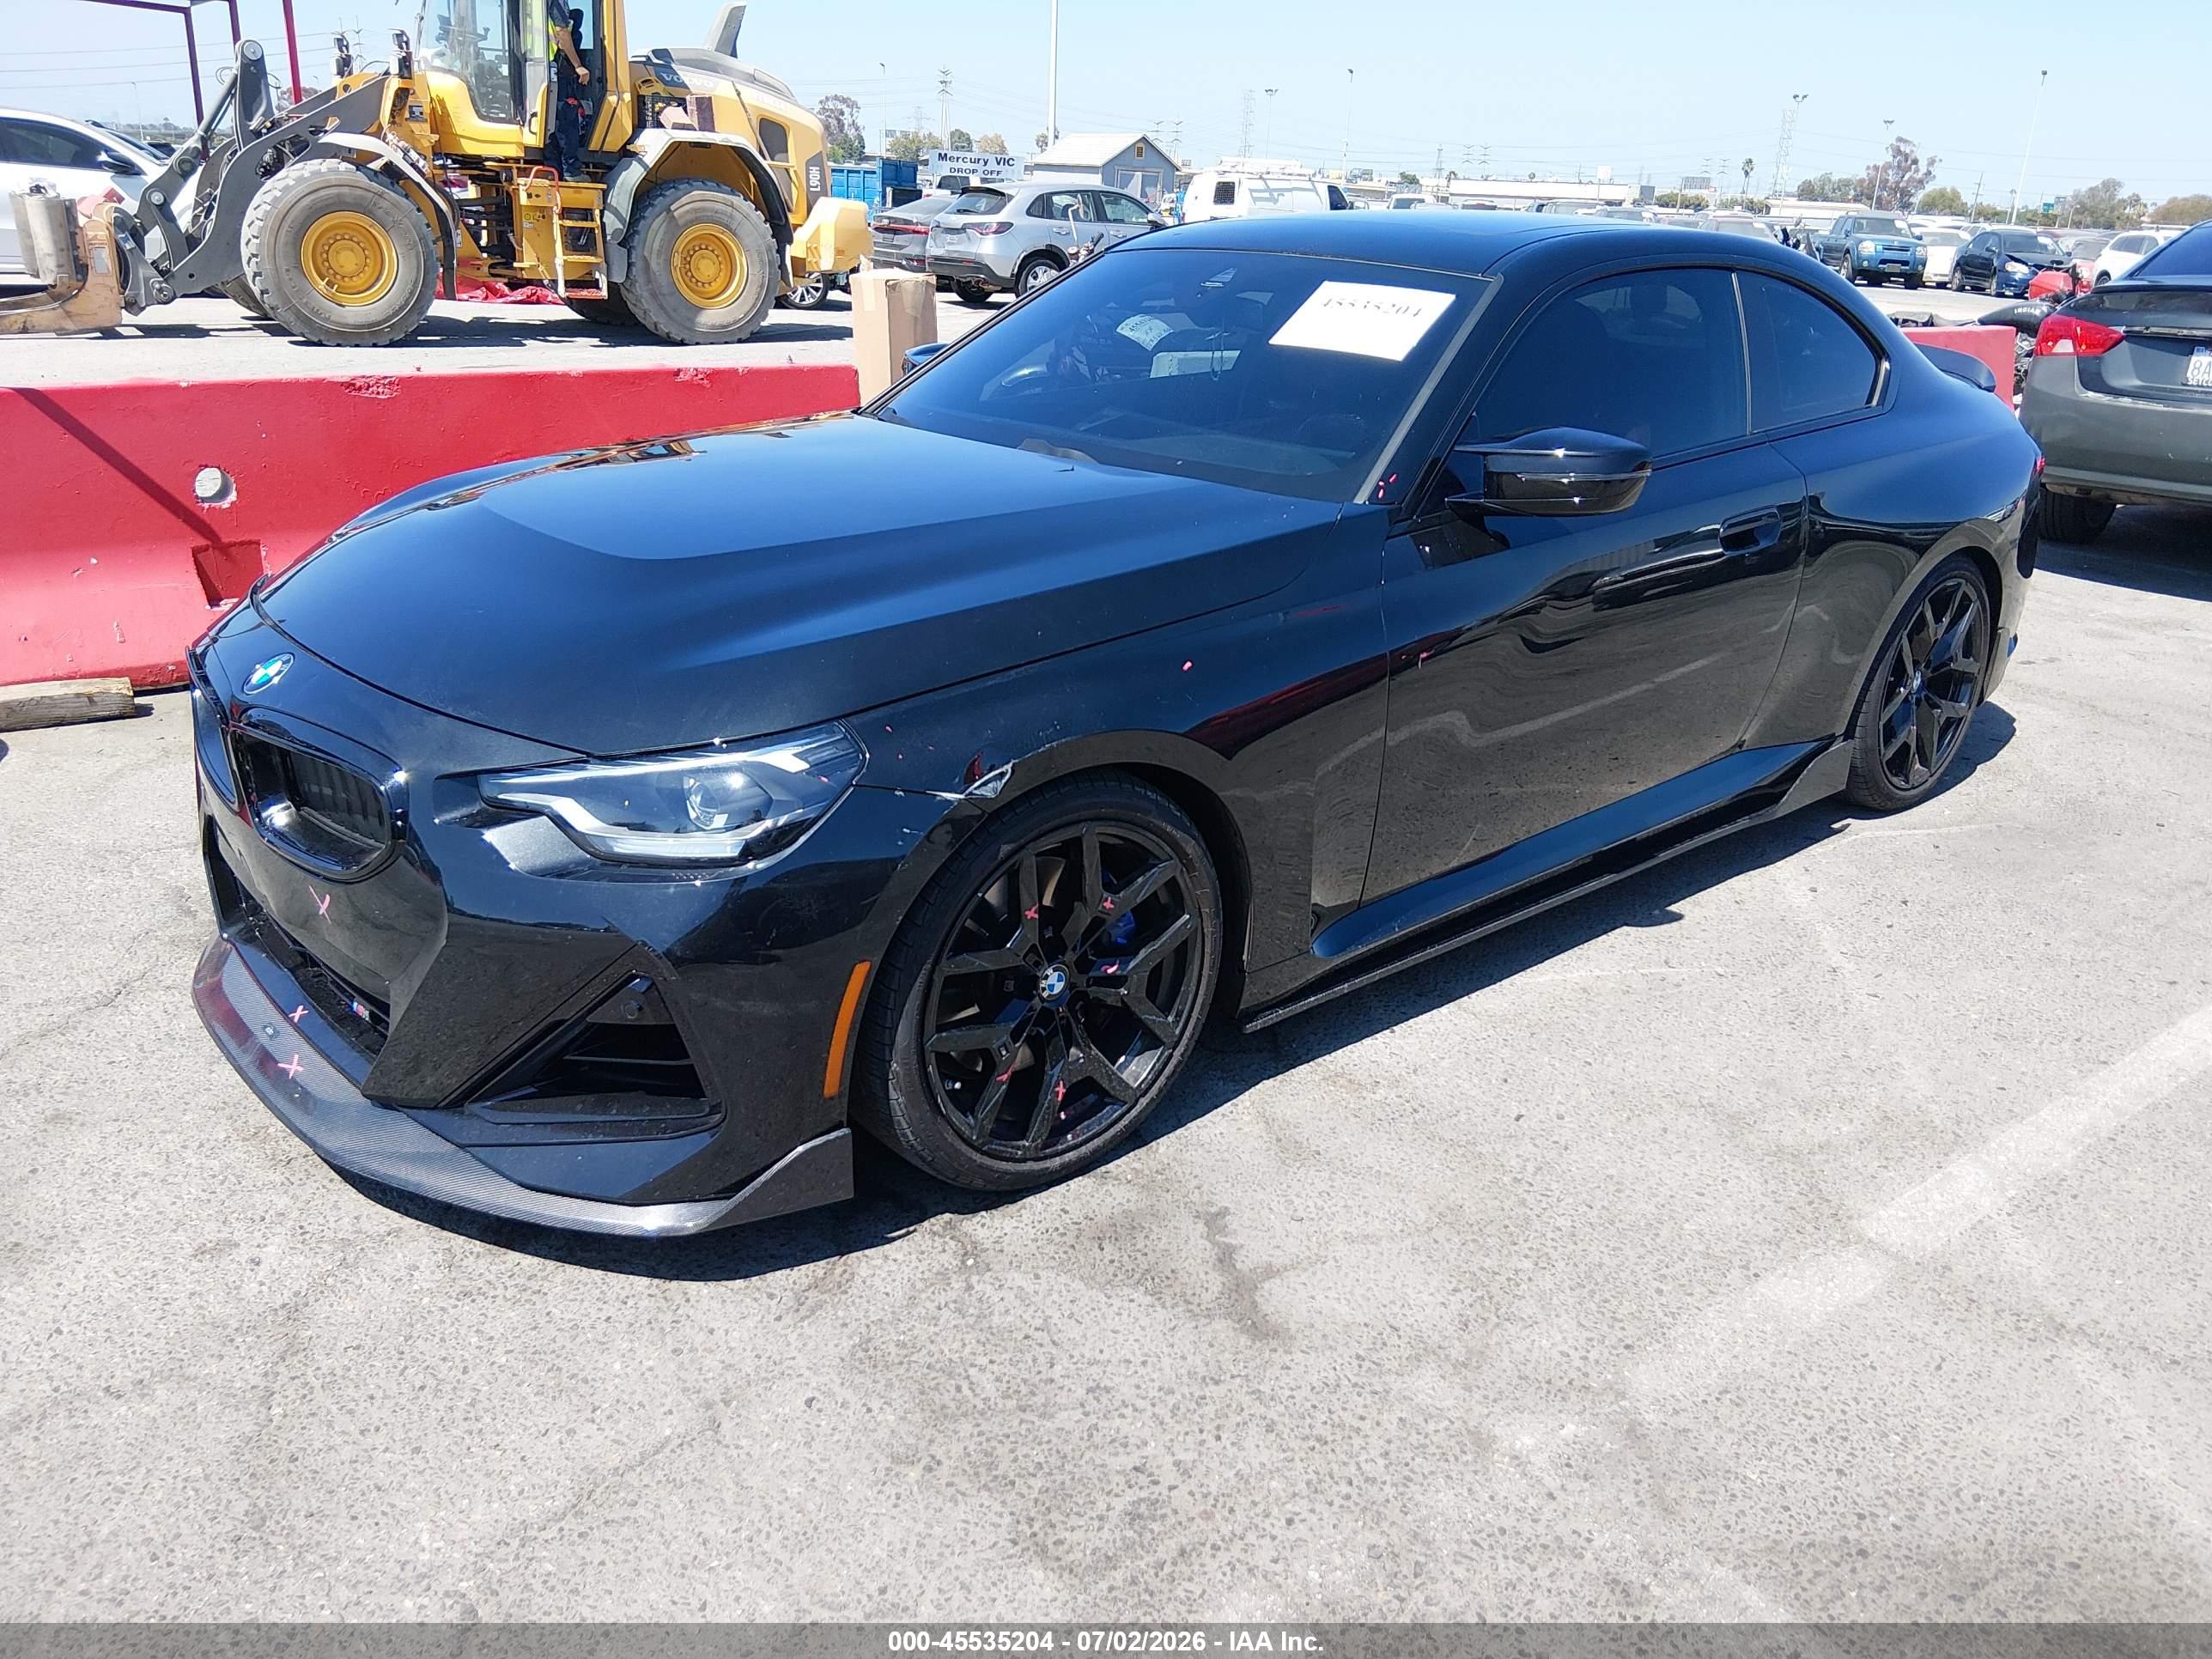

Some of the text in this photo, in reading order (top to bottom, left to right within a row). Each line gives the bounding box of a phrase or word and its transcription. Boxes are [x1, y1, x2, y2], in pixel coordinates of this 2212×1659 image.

[938, 152, 1016, 167] Mercury VIC
[809, 166, 821, 191] L90H
[949, 167, 978, 175] DROP
